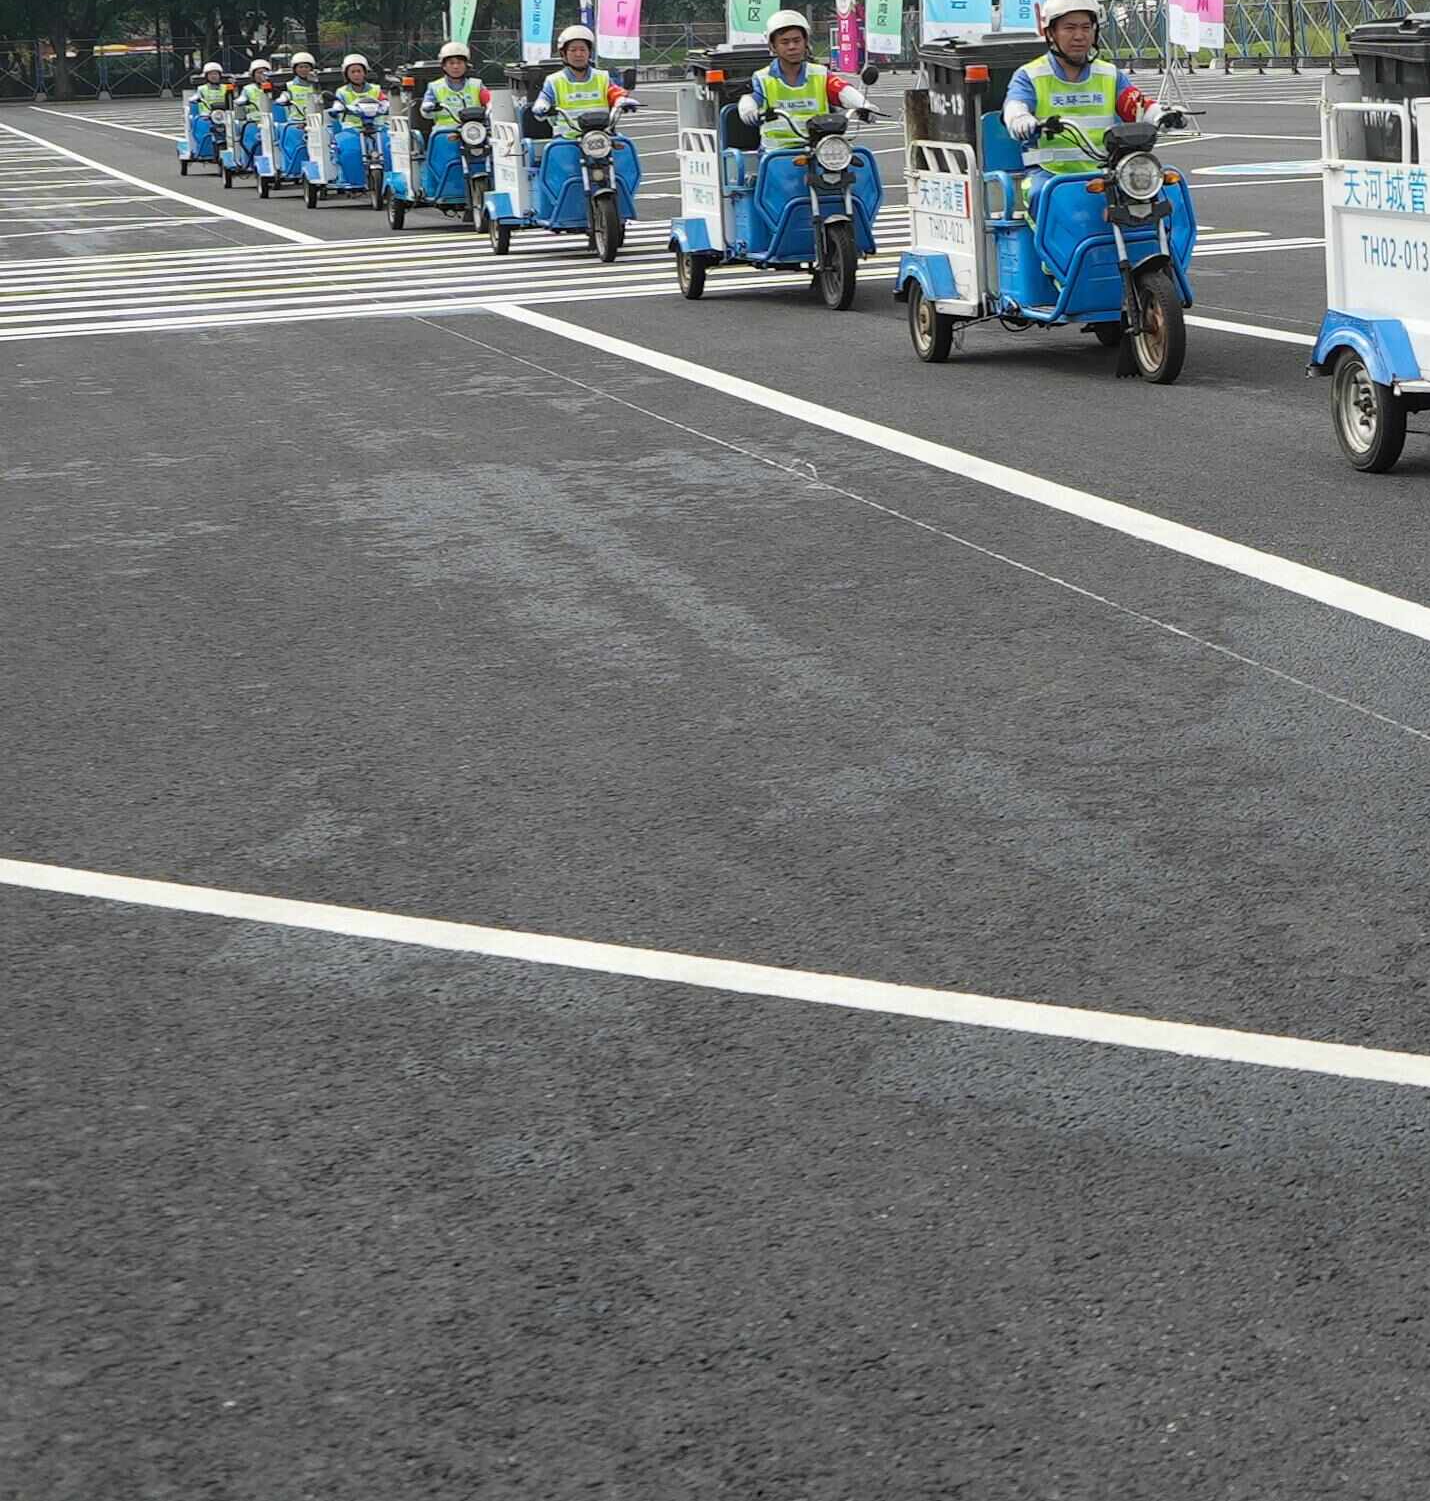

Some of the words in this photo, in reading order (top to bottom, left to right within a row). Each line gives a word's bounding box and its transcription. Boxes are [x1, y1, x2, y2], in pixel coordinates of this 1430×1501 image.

[1343, 167, 1428, 214] 天河城管
[1361, 235, 1429, 272] TH02-013
